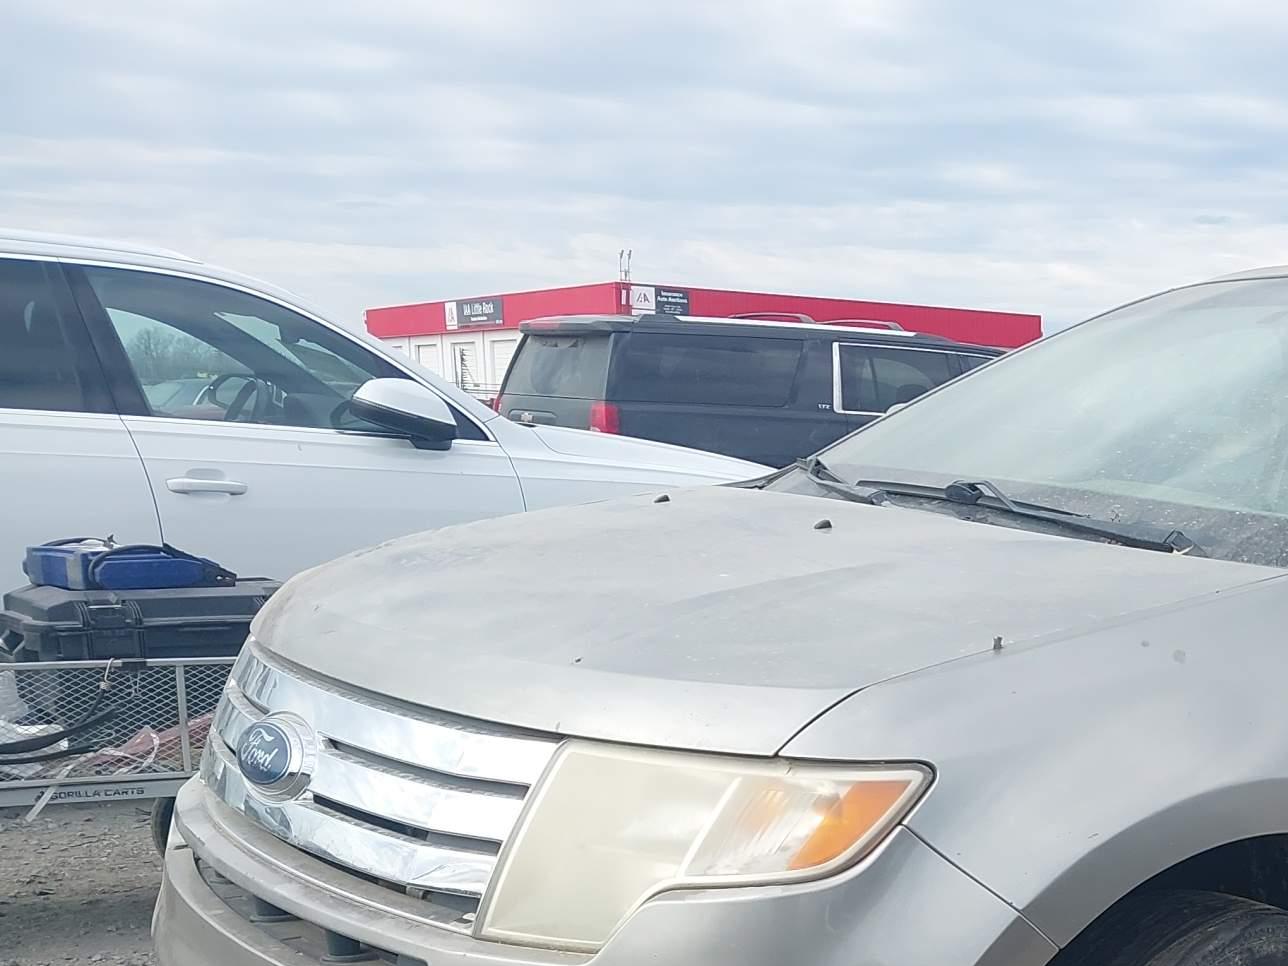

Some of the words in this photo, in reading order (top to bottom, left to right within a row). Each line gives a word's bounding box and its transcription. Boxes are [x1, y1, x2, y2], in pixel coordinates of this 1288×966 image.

[241, 727, 279, 770] Ford
[50, 789, 101, 800] GORILLA
[104, 787, 145, 797] CARTS
